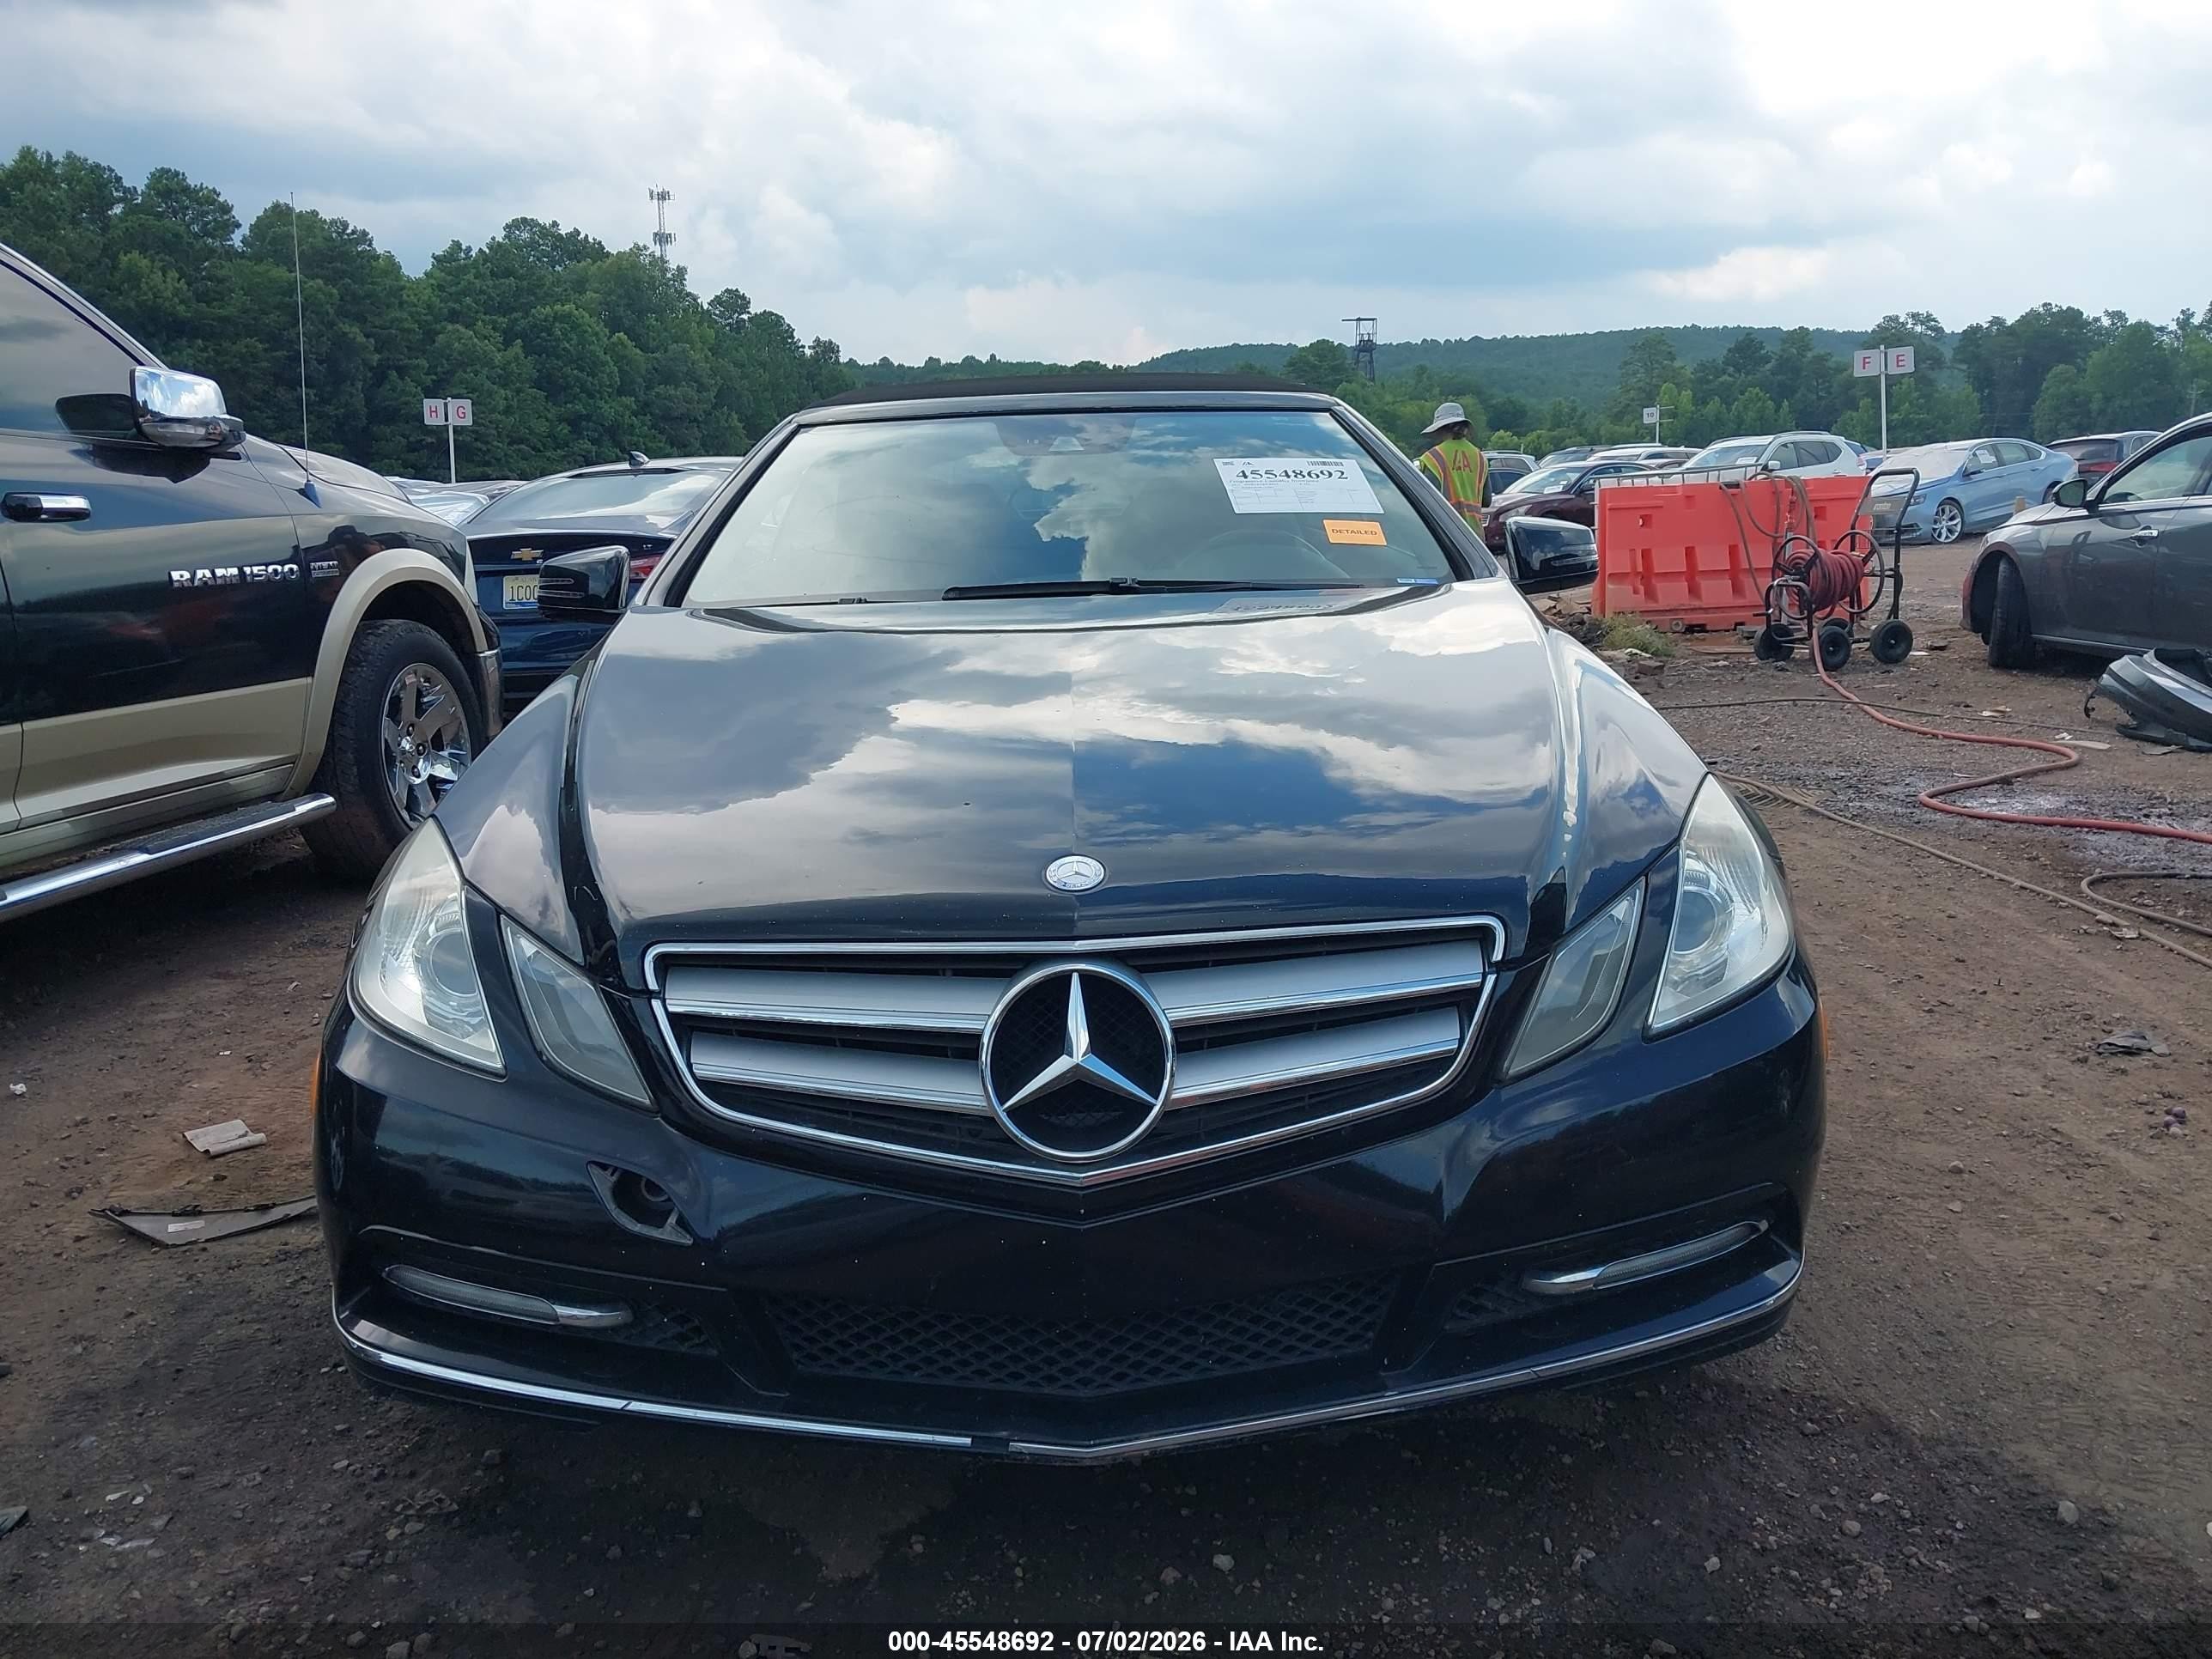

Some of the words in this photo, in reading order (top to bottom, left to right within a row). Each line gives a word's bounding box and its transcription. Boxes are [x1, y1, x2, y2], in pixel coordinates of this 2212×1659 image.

[1862, 356, 1872, 370] F
[1895, 353, 1906, 368] E
[428, 404, 439, 419] H
[456, 404, 466, 420] G
[1235, 469, 1349, 480] 45548692
[170, 567, 241, 587] RAM
[242, 563, 300, 583] 1500
